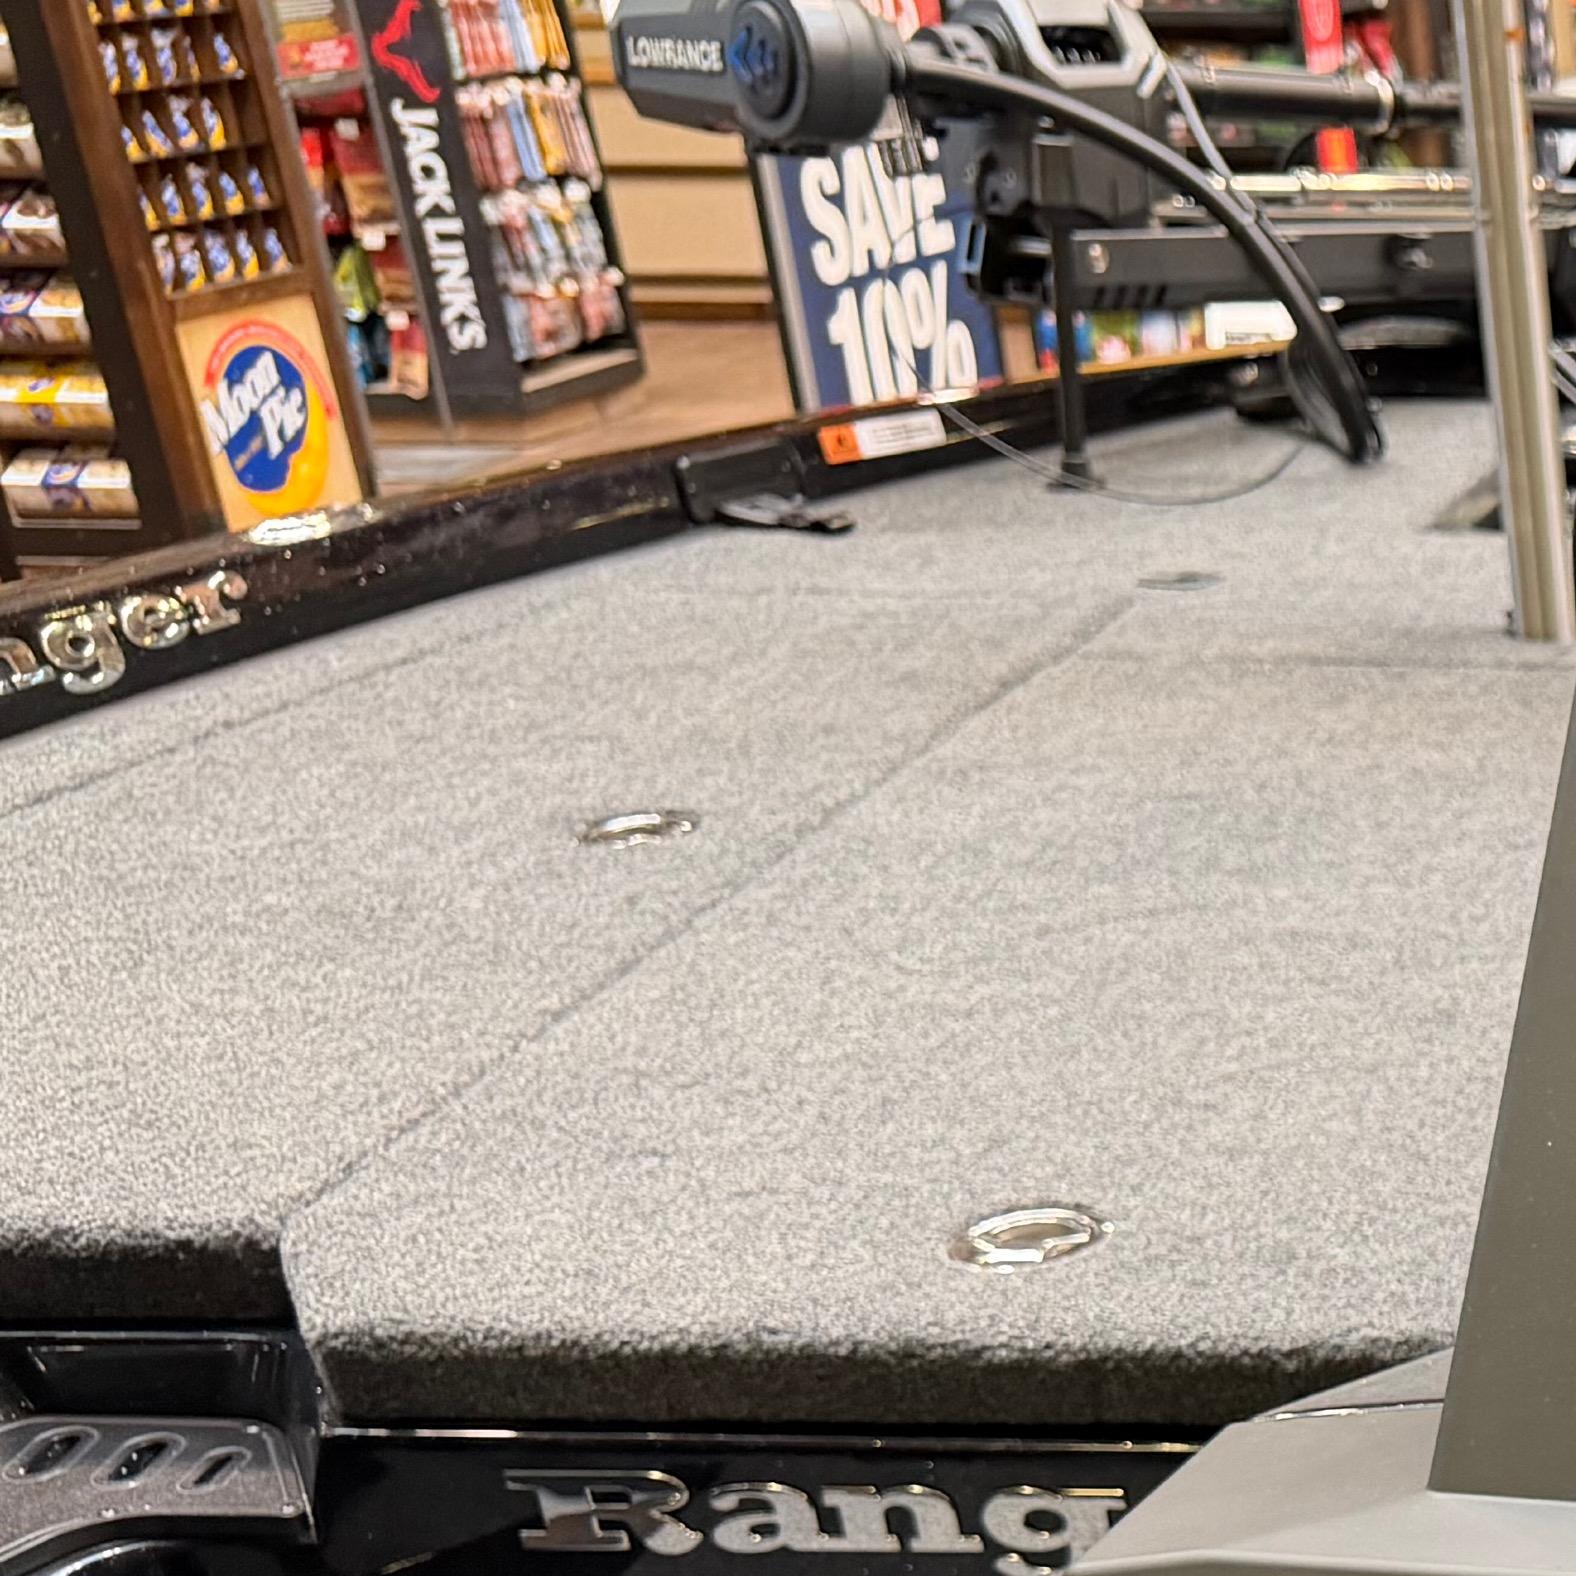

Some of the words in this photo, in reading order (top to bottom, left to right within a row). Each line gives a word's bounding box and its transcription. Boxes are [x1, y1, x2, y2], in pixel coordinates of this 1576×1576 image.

[625, 35, 724, 72] LOWRANCE
[390, 98, 456, 219] JACK
[799, 138, 956, 286] SAVE
[827, 260, 978, 406] 10%
